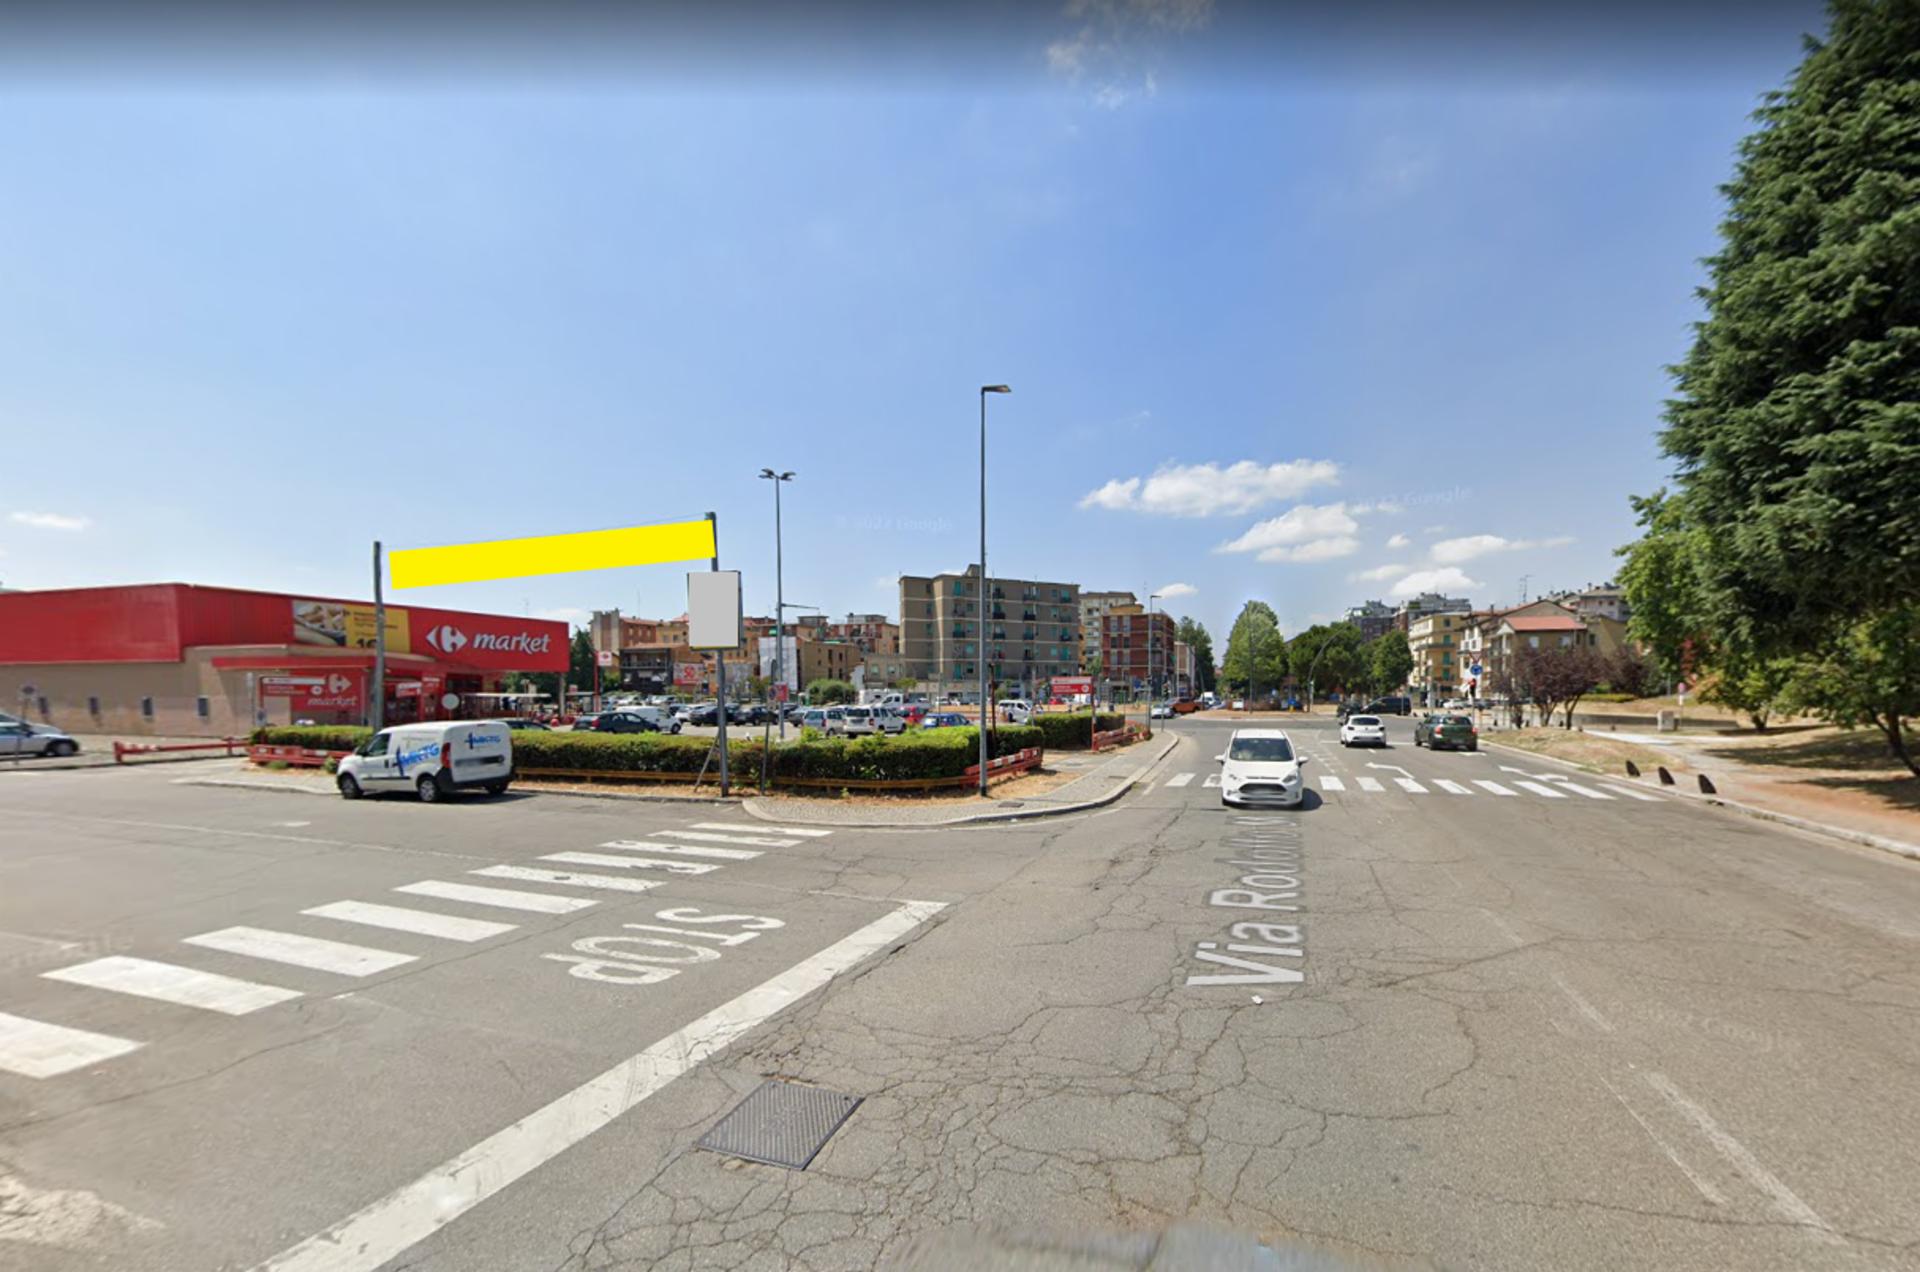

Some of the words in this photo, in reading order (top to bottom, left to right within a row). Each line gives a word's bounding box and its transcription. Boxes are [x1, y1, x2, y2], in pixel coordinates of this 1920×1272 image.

[473, 632, 550, 655] market
[307, 695, 358, 707] market
[540, 907, 786, 984] STOP
